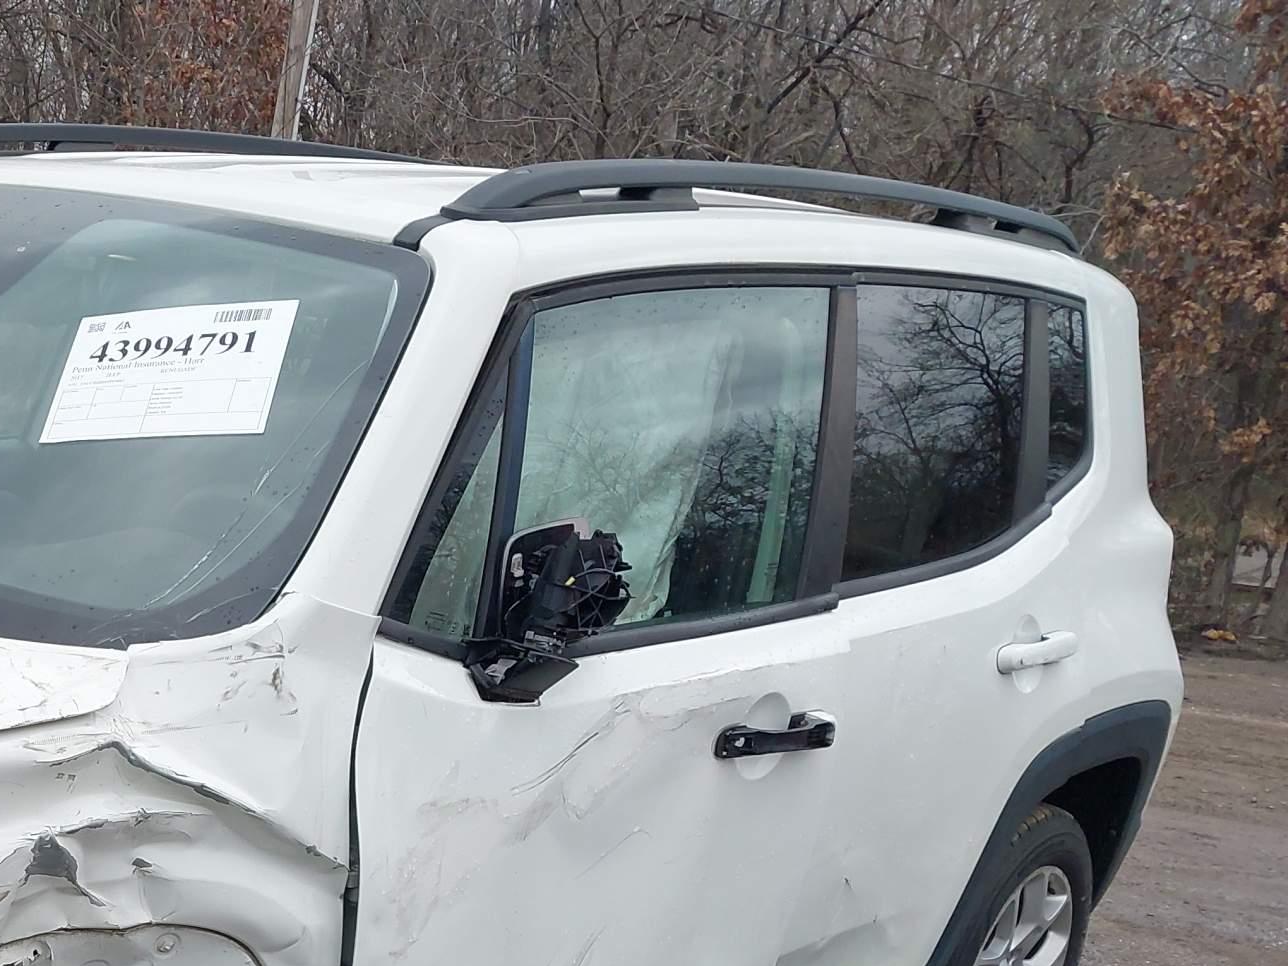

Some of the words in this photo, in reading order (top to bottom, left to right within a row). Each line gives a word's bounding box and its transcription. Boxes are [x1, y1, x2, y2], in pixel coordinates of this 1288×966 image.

[89, 330, 257, 363] 43994791
[72, 366, 93, 374] Penn
[95, 361, 132, 372] National
[133, 358, 176, 369] Insurance
